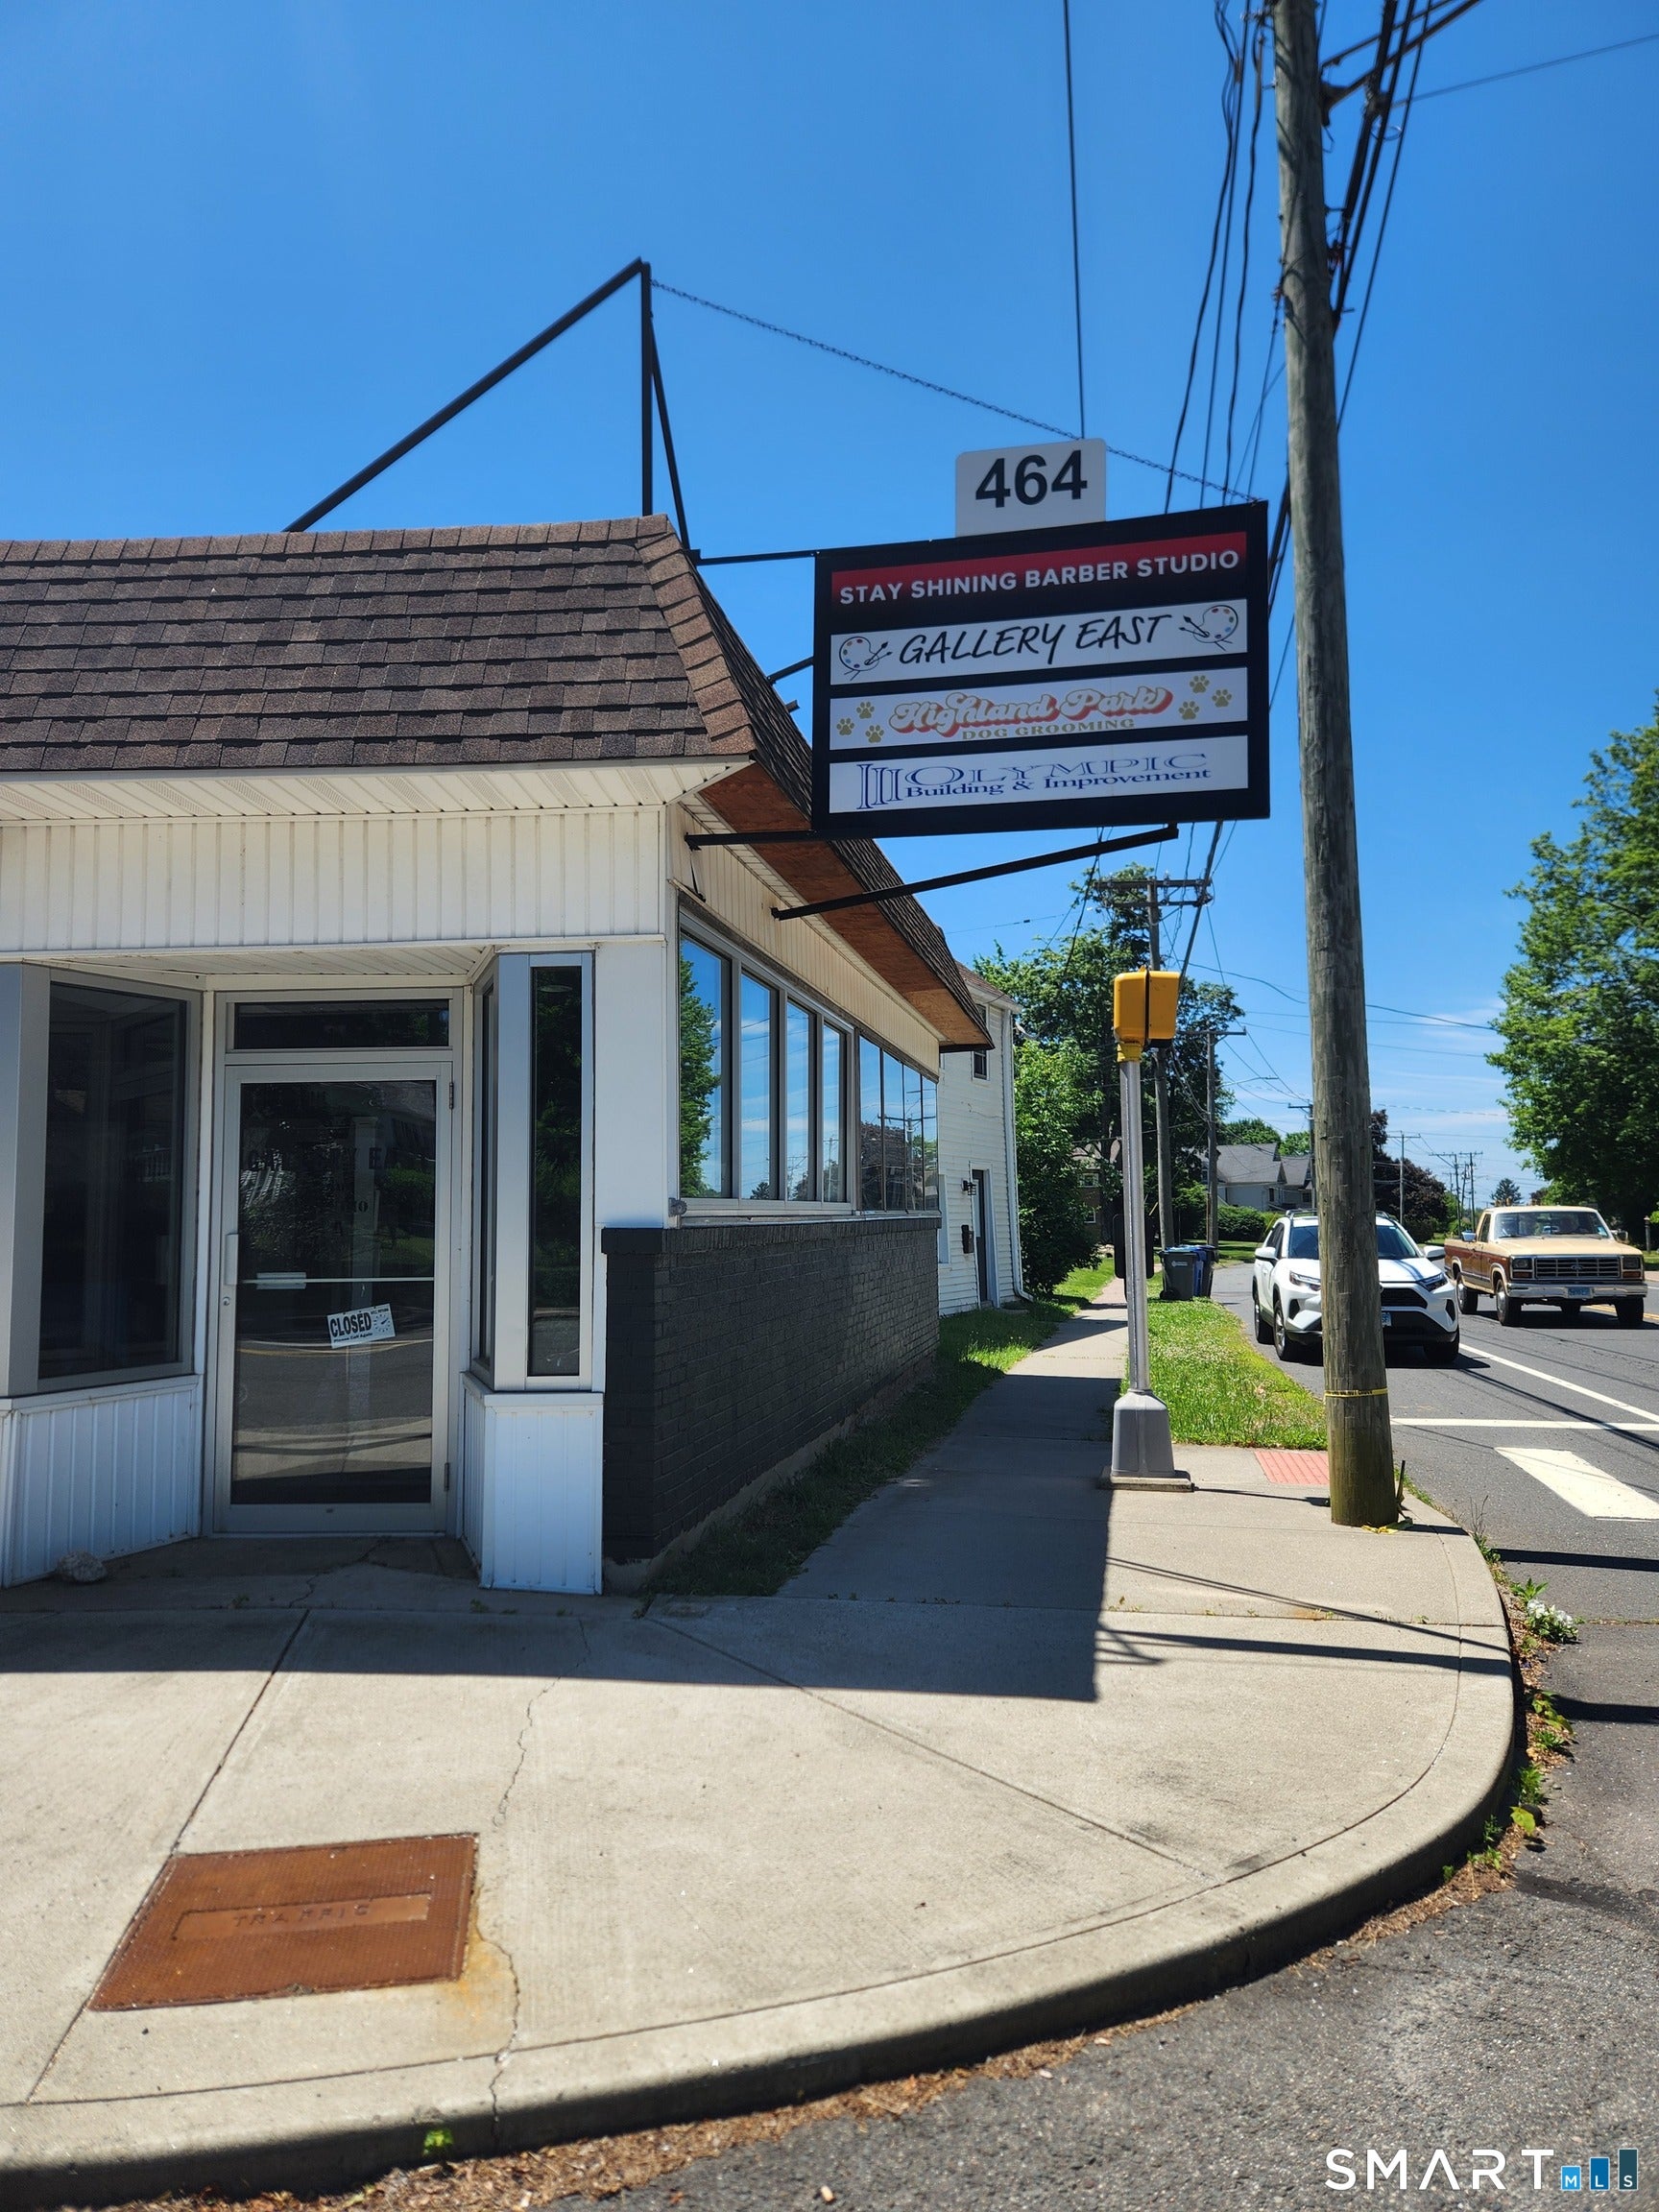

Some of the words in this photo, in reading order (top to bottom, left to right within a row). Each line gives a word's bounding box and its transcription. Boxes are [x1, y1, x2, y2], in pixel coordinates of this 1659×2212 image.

[975, 449, 1088, 508] 464
[839, 582, 902, 604] STAY
[911, 572, 1017, 598] SHINING
[1024, 561, 1128, 588] BARBER
[1137, 550, 1238, 577] STUDIO
[899, 622, 1066, 665] GALLERY
[1075, 614, 1172, 649] EAST
[889, 691, 1060, 738] Highland
[1059, 685, 1174, 721] Park
[962, 729, 1008, 740] DOG
[1015, 718, 1135, 738] GROOMING
[904, 753, 1207, 787] OLYMPIC
[906, 782, 1004, 798] Building
[1013, 781, 1036, 791] &
[1044, 769, 1212, 790] Improvement
[329, 1311, 372, 1337] CLOSED
[233, 1904, 371, 1928] TRAFFIC
